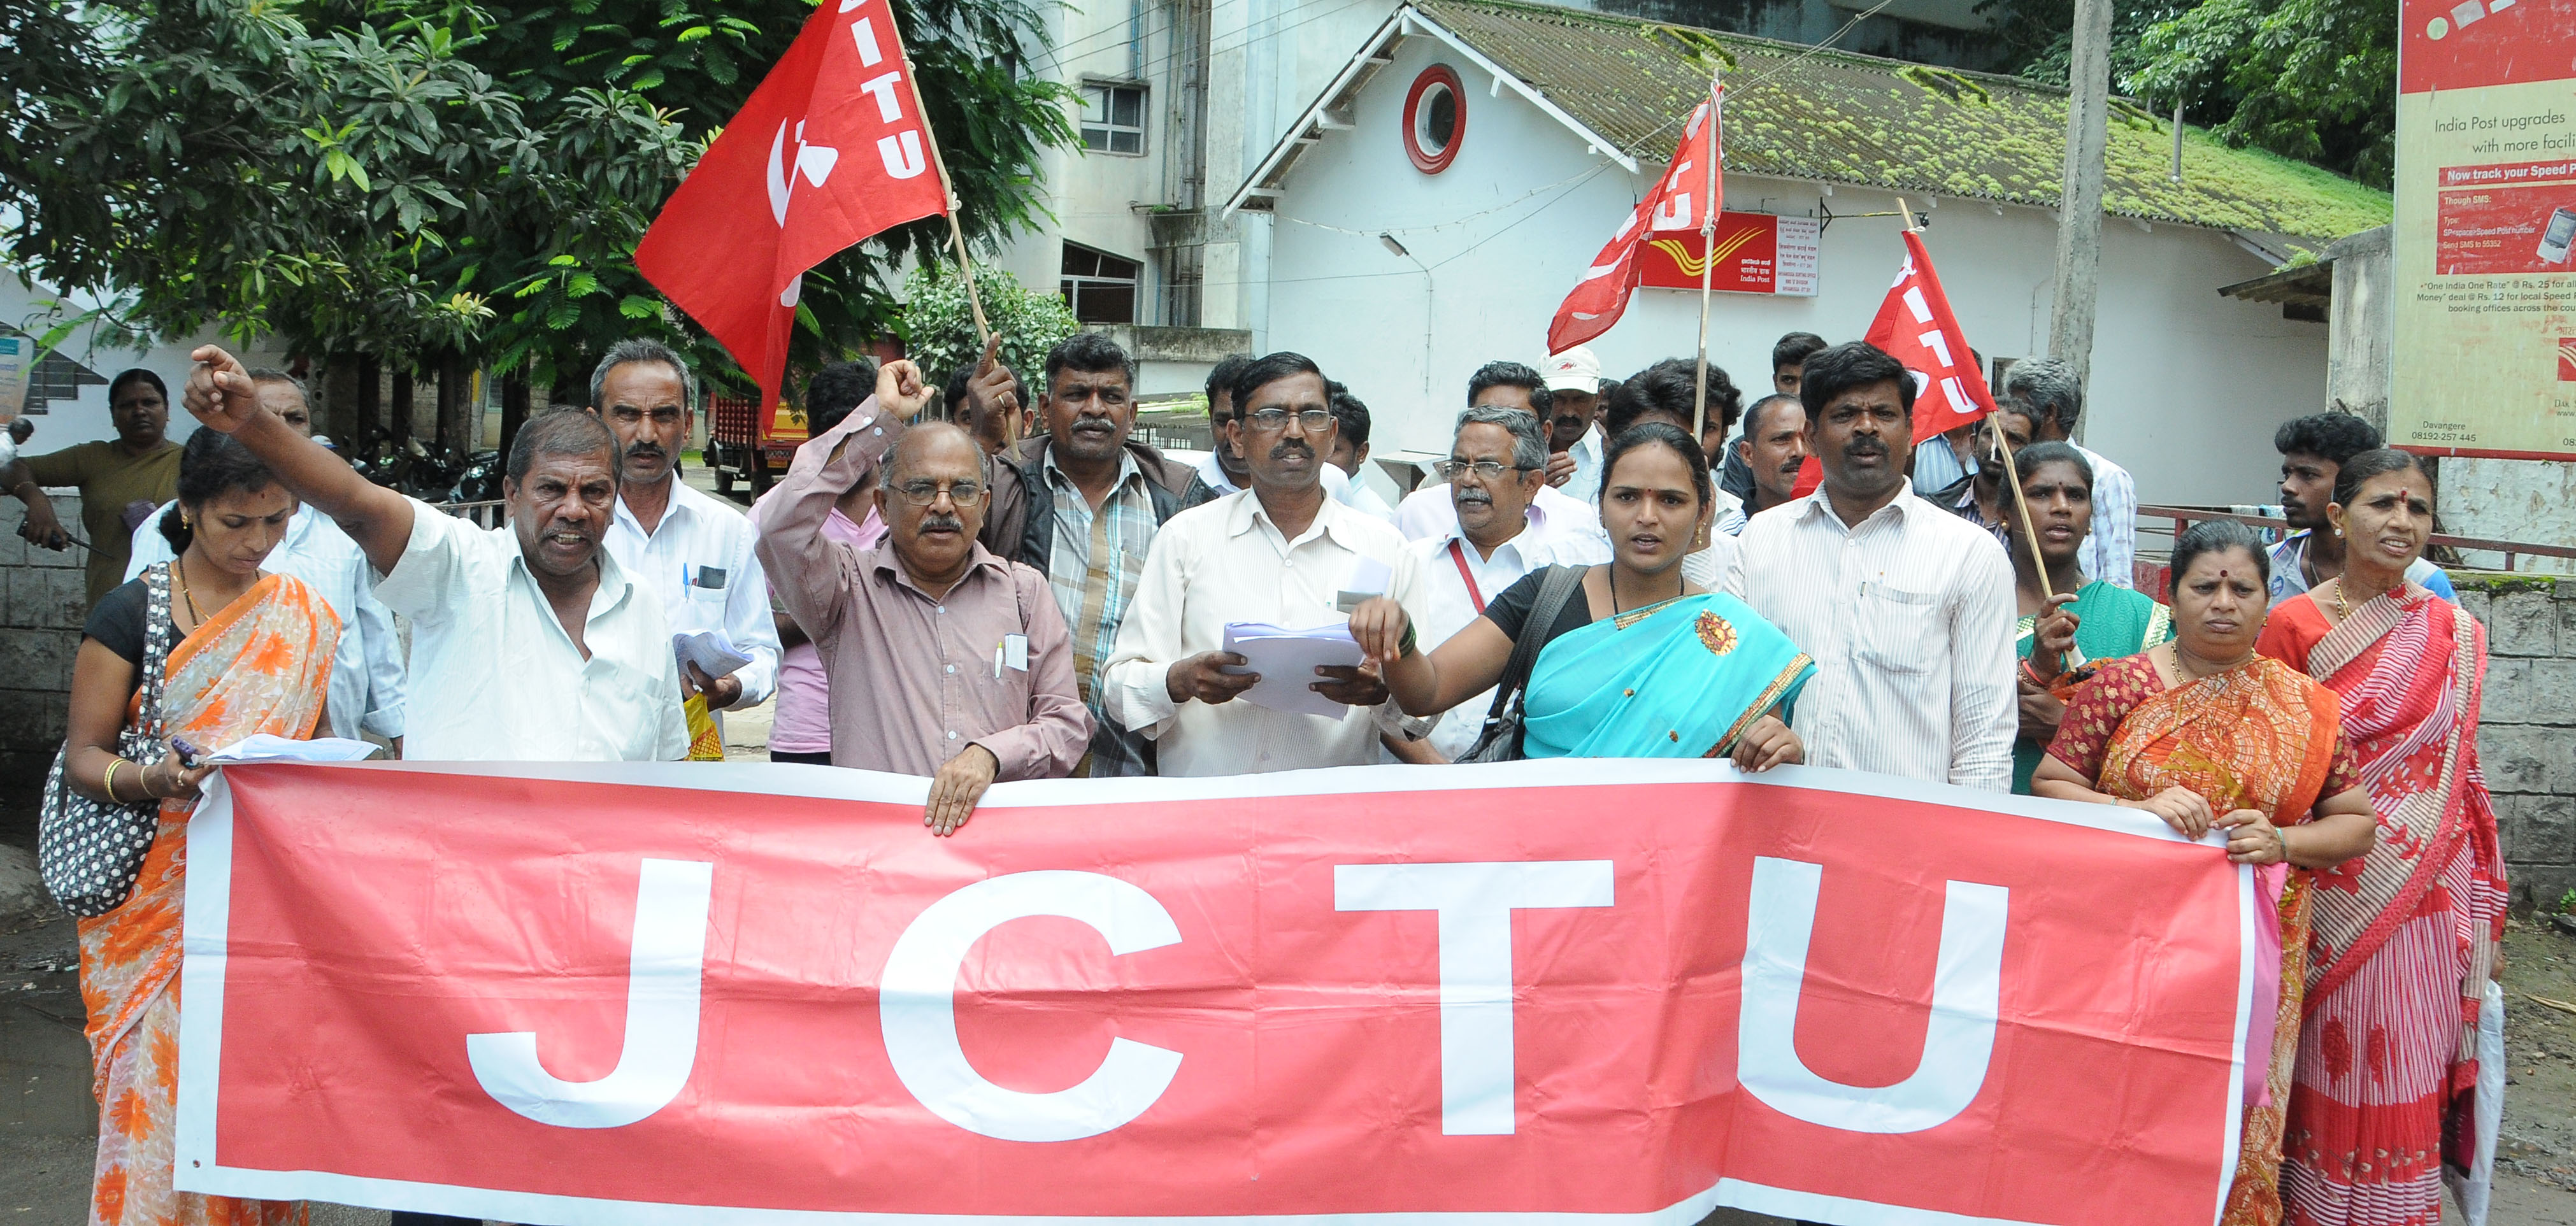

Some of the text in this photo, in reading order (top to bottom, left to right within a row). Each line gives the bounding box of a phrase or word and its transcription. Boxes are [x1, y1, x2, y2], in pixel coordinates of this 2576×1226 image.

[838, 0, 926, 179] ITU
[2435, 109, 2566, 132] India Post upgrades
[2473, 138, 2499, 153] with
[2504, 141, 2538, 152] more
[2447, 171, 2471, 181] Now
[2473, 168, 2502, 179] track
[2504, 168, 2529, 180] your
[2530, 164, 2566, 178] Speed
[2445, 195, 2492, 206] Though SMS:
[2522, 280, 2535, 289] Rs.
[2538, 280, 2550, 289] 25
[2552, 280, 2565, 288] for
[2544, 292, 2571, 301] Speed
[2448, 305, 2481, 314] booking
[2422, 420, 2466, 431] Davangere
[2412, 432, 2457, 441] 08192-257
[2563, 438, 2576, 446] 08
